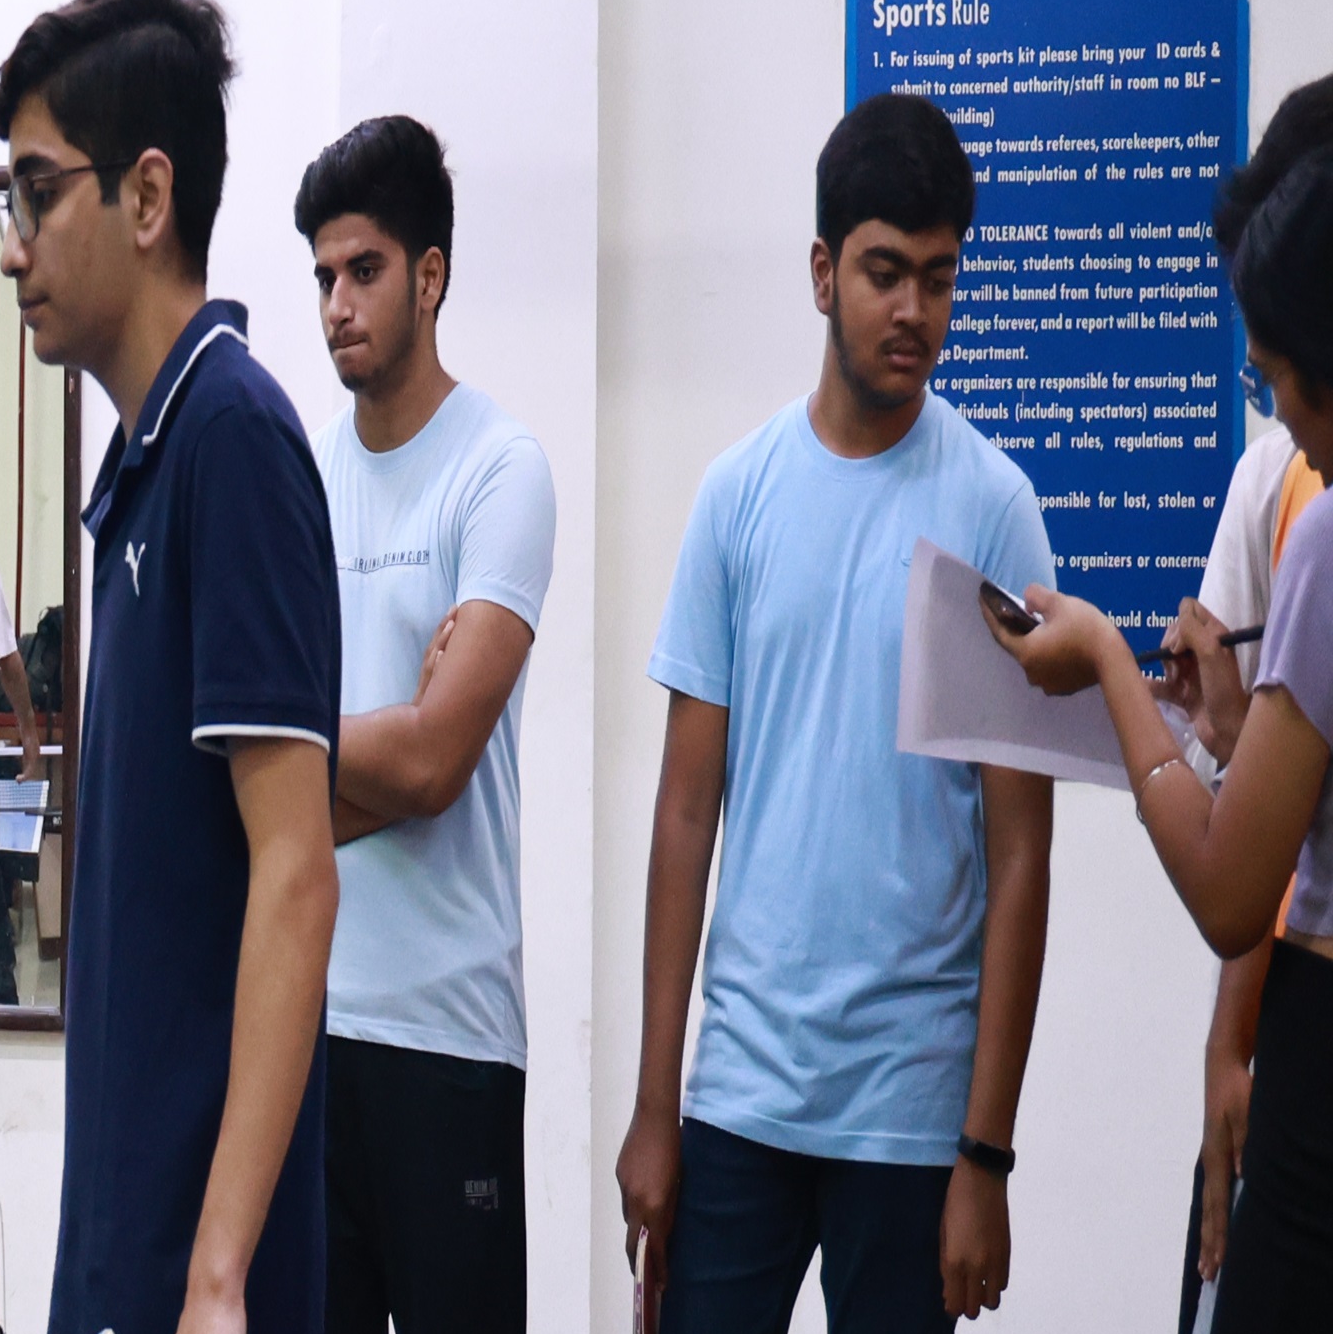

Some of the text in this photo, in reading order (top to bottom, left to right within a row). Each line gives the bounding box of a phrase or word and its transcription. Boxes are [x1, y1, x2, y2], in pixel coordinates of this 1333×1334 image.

[873, 40, 1221, 70] 1. For issuing of sports kit please bring your ID cards &
[933, 80, 947, 96] to
[949, 76, 1008, 95] concerned
[1013, 73, 1105, 96] authority/staff
[1110, 74, 1123, 90] in
[1127, 77, 1159, 90] room
[1164, 76, 1180, 89] no
[1184, 71, 1206, 89] BLF
[962, 130, 1220, 157] uage towards referees, scorekeepers, other
[973, 162, 1220, 186] nd manipulation of the rules are not
[979, 224, 1049, 242] TOLERANCE
[1054, 223, 1103, 241] towards
[1108, 222, 1124, 240] all
[1129, 222, 1172, 239] violent
[962, 254, 1017, 274] behavior,
[1022, 253, 1075, 271] students
[1080, 253, 1132, 274] choosing
[1137, 254, 1151, 269] to
[1156, 256, 1201, 273] engage
[1206, 252, 1218, 268] in
[970, 284, 993, 301] will
[994, 284, 1009, 301] be
[1012, 283, 1057, 301] banned
[1059, 283, 1089, 300] from
[1094, 282, 1134, 300] future
[1139, 282, 1218, 303] participation
[950, 311, 1218, 335] college forever, and a report will be filed with
[953, 344, 1029, 365] Department.
[934, 378, 948, 391] or
[950, 373, 1013, 394] organizers
[1016, 377, 1037, 390] are
[1040, 371, 1109, 393] responsible
[1112, 372, 1131, 389] for
[1134, 371, 1187, 393] ensuring
[1190, 371, 1217, 388] that
[1015, 402, 1074, 423] (including
[1080, 402, 1147, 423] spectators)
[1153, 401, 1217, 419] associated
[1045, 431, 1061, 449] all
[1070, 431, 1104, 451] rules,
[1114, 431, 1184, 453] regulations
[1193, 431, 1217, 448] and
[1098, 491, 1117, 508] for
[1123, 491, 1151, 510] lost,
[1158, 491, 1196, 508] stolen
[1202, 496, 1216, 508] or
[1069, 551, 1132, 572] organizers
[1137, 555, 1150, 568] or
